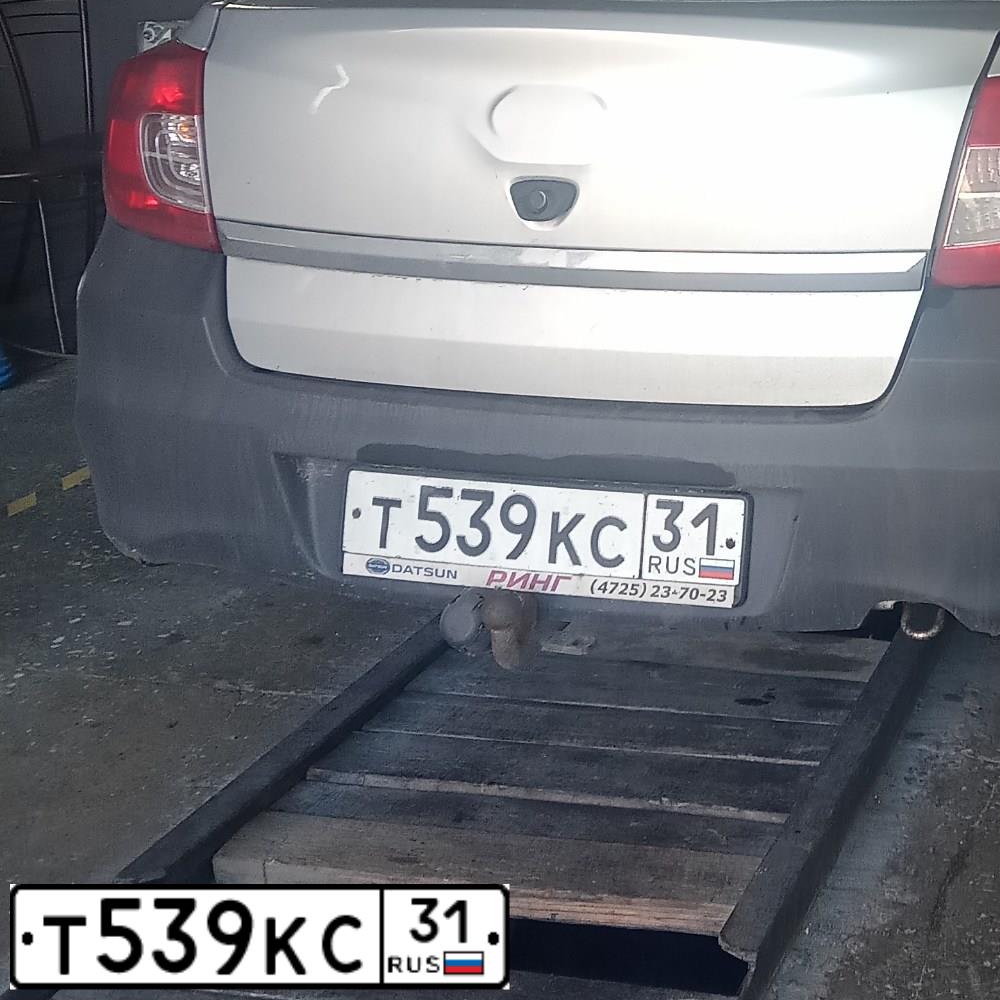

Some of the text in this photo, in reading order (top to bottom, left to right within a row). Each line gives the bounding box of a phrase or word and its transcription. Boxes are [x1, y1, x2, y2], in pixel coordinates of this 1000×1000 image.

[652, 500, 719, 556] 31
[391, 564, 458, 580] DATSUN
[648, 555, 696, 576] RUS
[486, 569, 573, 592] РИНГ
[590, 579, 728, 603] (4725) 23-70-23
